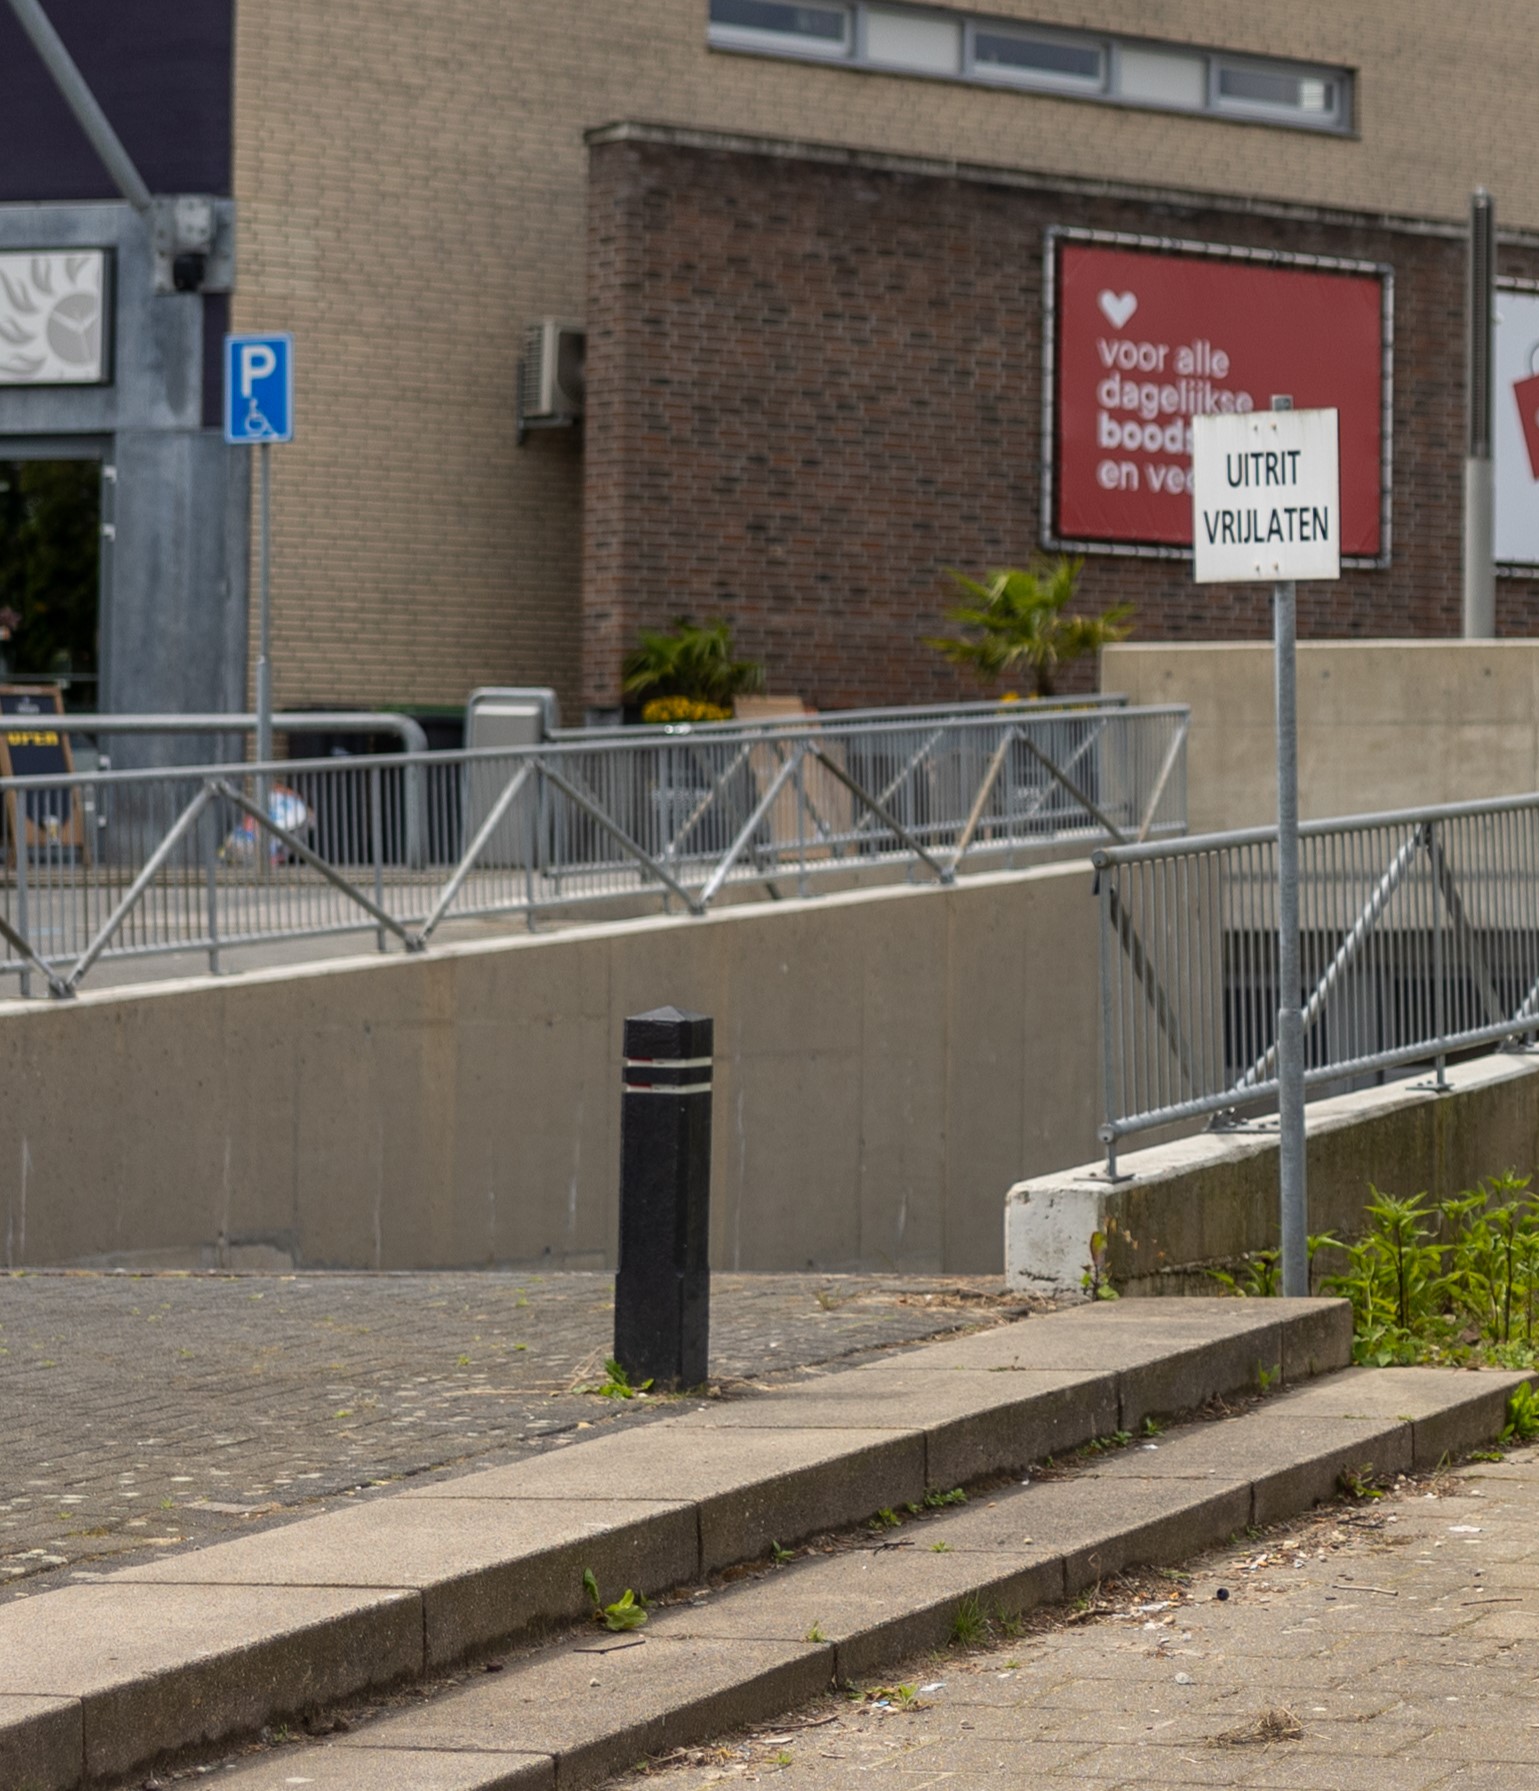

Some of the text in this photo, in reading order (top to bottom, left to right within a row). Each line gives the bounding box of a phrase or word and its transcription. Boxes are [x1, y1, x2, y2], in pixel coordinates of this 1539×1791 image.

[242, 345, 276, 398] P
[1097, 337, 1230, 379] voor alle
[1097, 370, 1254, 420] dagelijkse
[1097, 459, 1139, 491] en
[1226, 450, 1301, 488] UITRIT
[1203, 505, 1328, 544] VRIJLATEN
